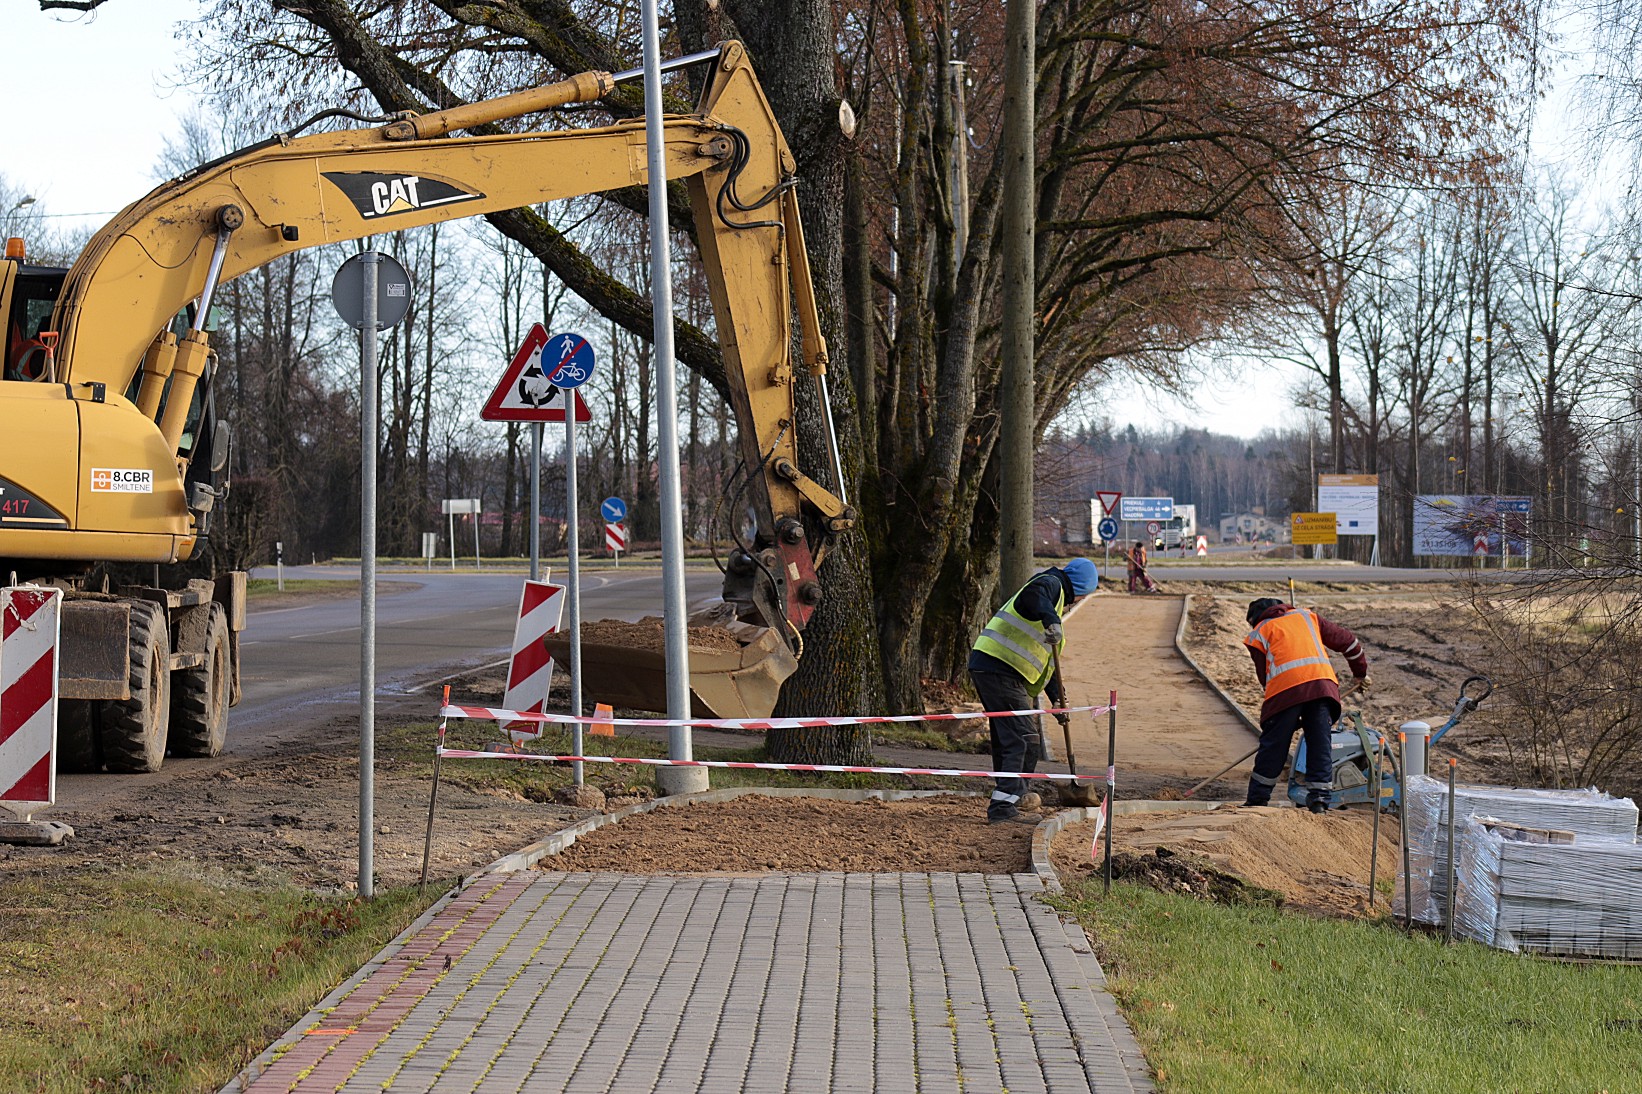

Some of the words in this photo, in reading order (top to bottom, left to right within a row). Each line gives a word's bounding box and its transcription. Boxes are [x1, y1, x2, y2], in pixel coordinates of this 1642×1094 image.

[371, 176, 419, 215] CAT
[112, 471, 150, 483] 8.CBR
[112, 483, 151, 492] SMILTENE
[2, 499, 30, 514] 417
